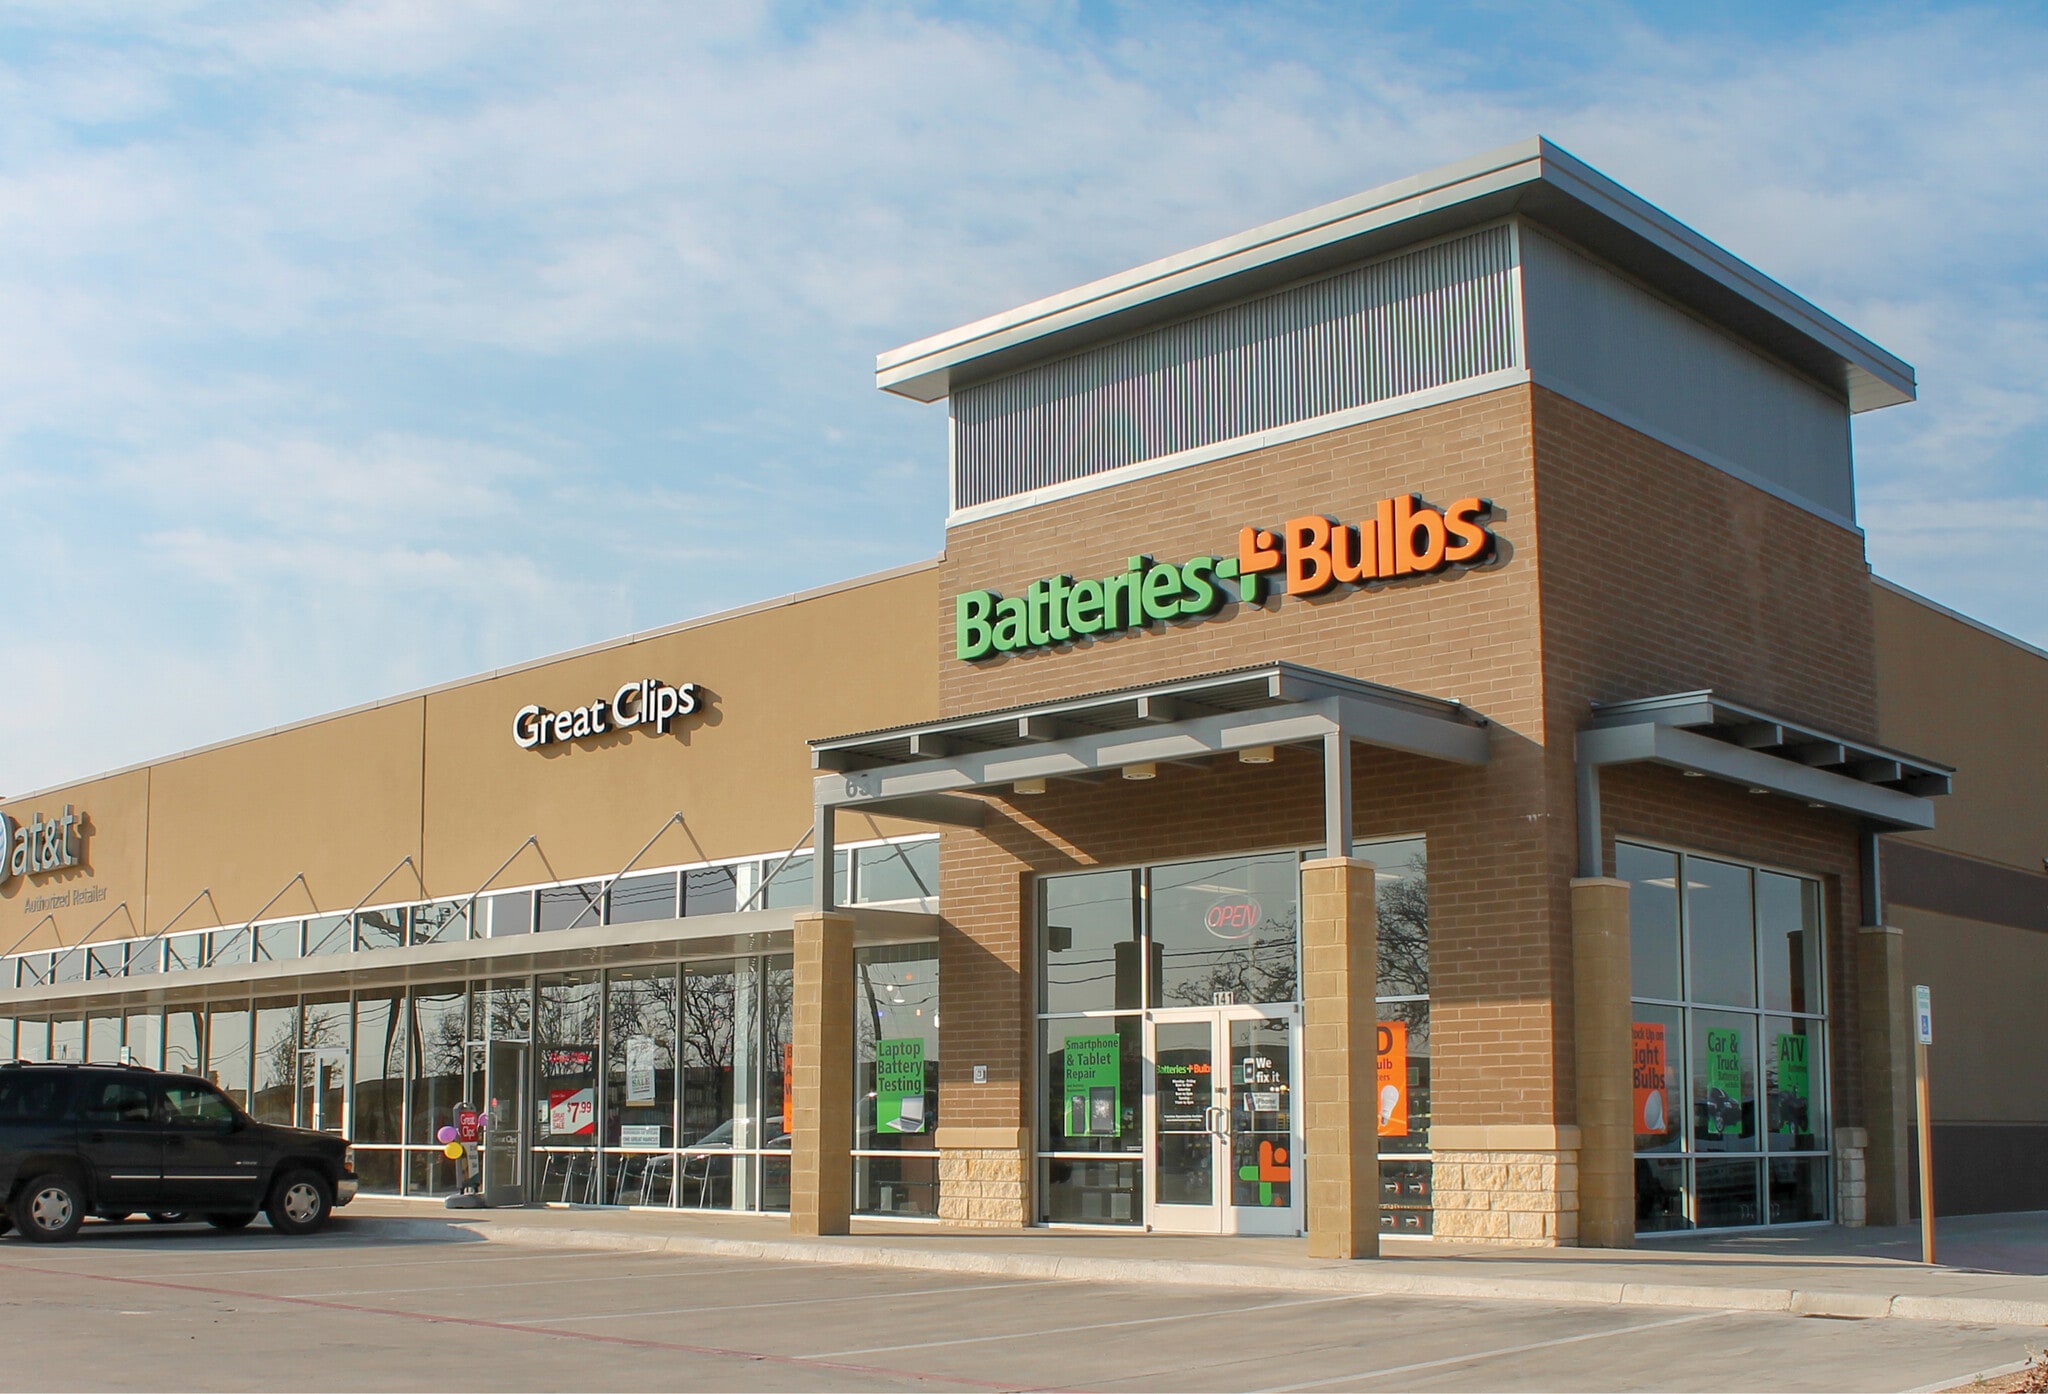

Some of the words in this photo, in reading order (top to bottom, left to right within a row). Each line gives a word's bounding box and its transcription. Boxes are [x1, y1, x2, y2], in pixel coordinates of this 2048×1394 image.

[956, 554, 1215, 661] Batteries
[1285, 493, 1489, 597] Bulbs
[512, 699, 606, 749] Great
[612, 678, 696, 735] Clips
[11, 804, 79, 876] at&t
[24, 889, 70, 913] Authorized
[72, 885, 107, 906] Retailer
[1208, 904, 1258, 927] OPEN
[1215, 992, 1231, 1006] 141
[879, 1042, 921, 1059] Laptop
[1066, 1038, 1119, 1051] Smartphone
[1708, 1032, 1726, 1052] Car
[1730, 1033, 1738, 1053] &
[1781, 1037, 1804, 1061] ATV
[1067, 1054, 1074, 1066] &
[1078, 1052, 1111, 1065] Tablet
[1256, 1057, 1272, 1068] We
[1633, 1043, 1659, 1070] ight
[1717, 1055, 1739, 1070] Truck
[878, 1060, 922, 1076] Battery
[1067, 1067, 1096, 1081] Repair
[1194, 1063, 1211, 1074] Bulb
[878, 1076, 922, 1094] Testing
[1256, 1071, 1270, 1083] fix
[1272, 1071, 1280, 1082] it
[1633, 1067, 1665, 1089] Bulbs
[460, 1113, 475, 1125] Great
[567, 1101, 592, 1123] $7.99
[462, 1126, 475, 1140] Clips
